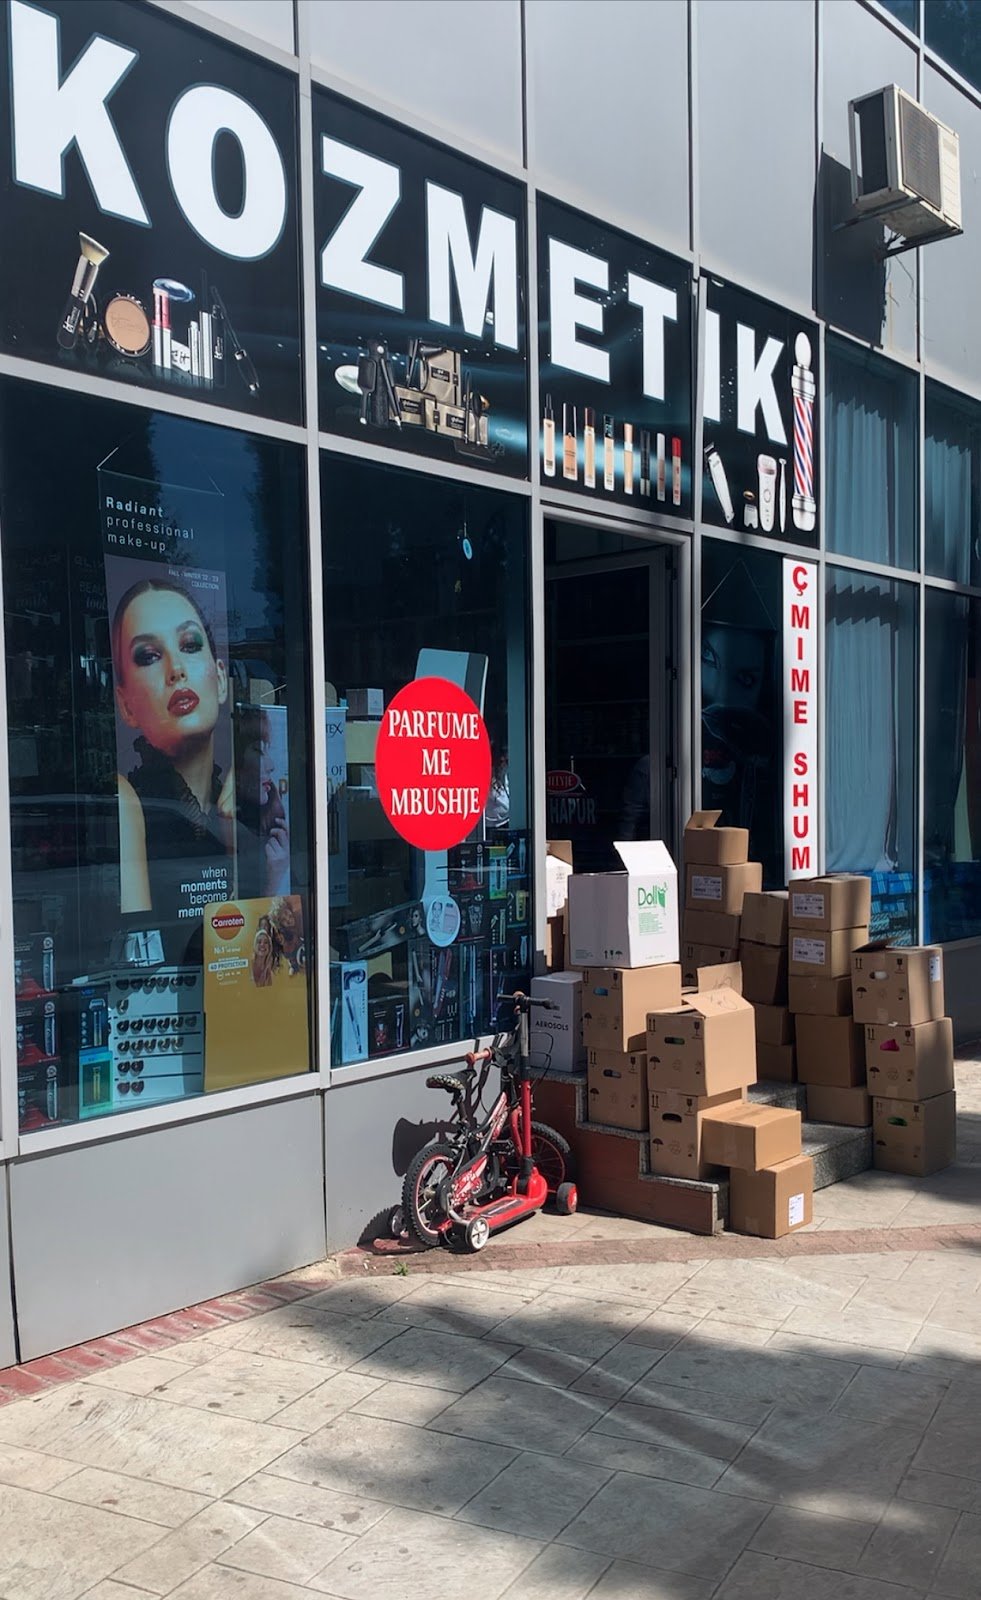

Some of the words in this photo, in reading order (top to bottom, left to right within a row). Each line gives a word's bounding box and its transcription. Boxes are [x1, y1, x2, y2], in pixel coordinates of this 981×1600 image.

[106, 496, 164, 518] Radiant
[106, 515, 195, 540] professional
[107, 531, 166, 553] make-up
[191, 580, 220, 590] COLLECTION
[790, 566, 811, 725] ÇMIME
[387, 709, 480, 740] PARFUME
[421, 749, 451, 776] ME
[390, 787, 480, 820] MBUSHJE
[201, 866, 228, 879] when
[180, 878, 228, 893] moments
[189, 892, 228, 905] become
[212, 917, 244, 927] Carroten
[535, 1020, 569, 1032] AEROSOLS
